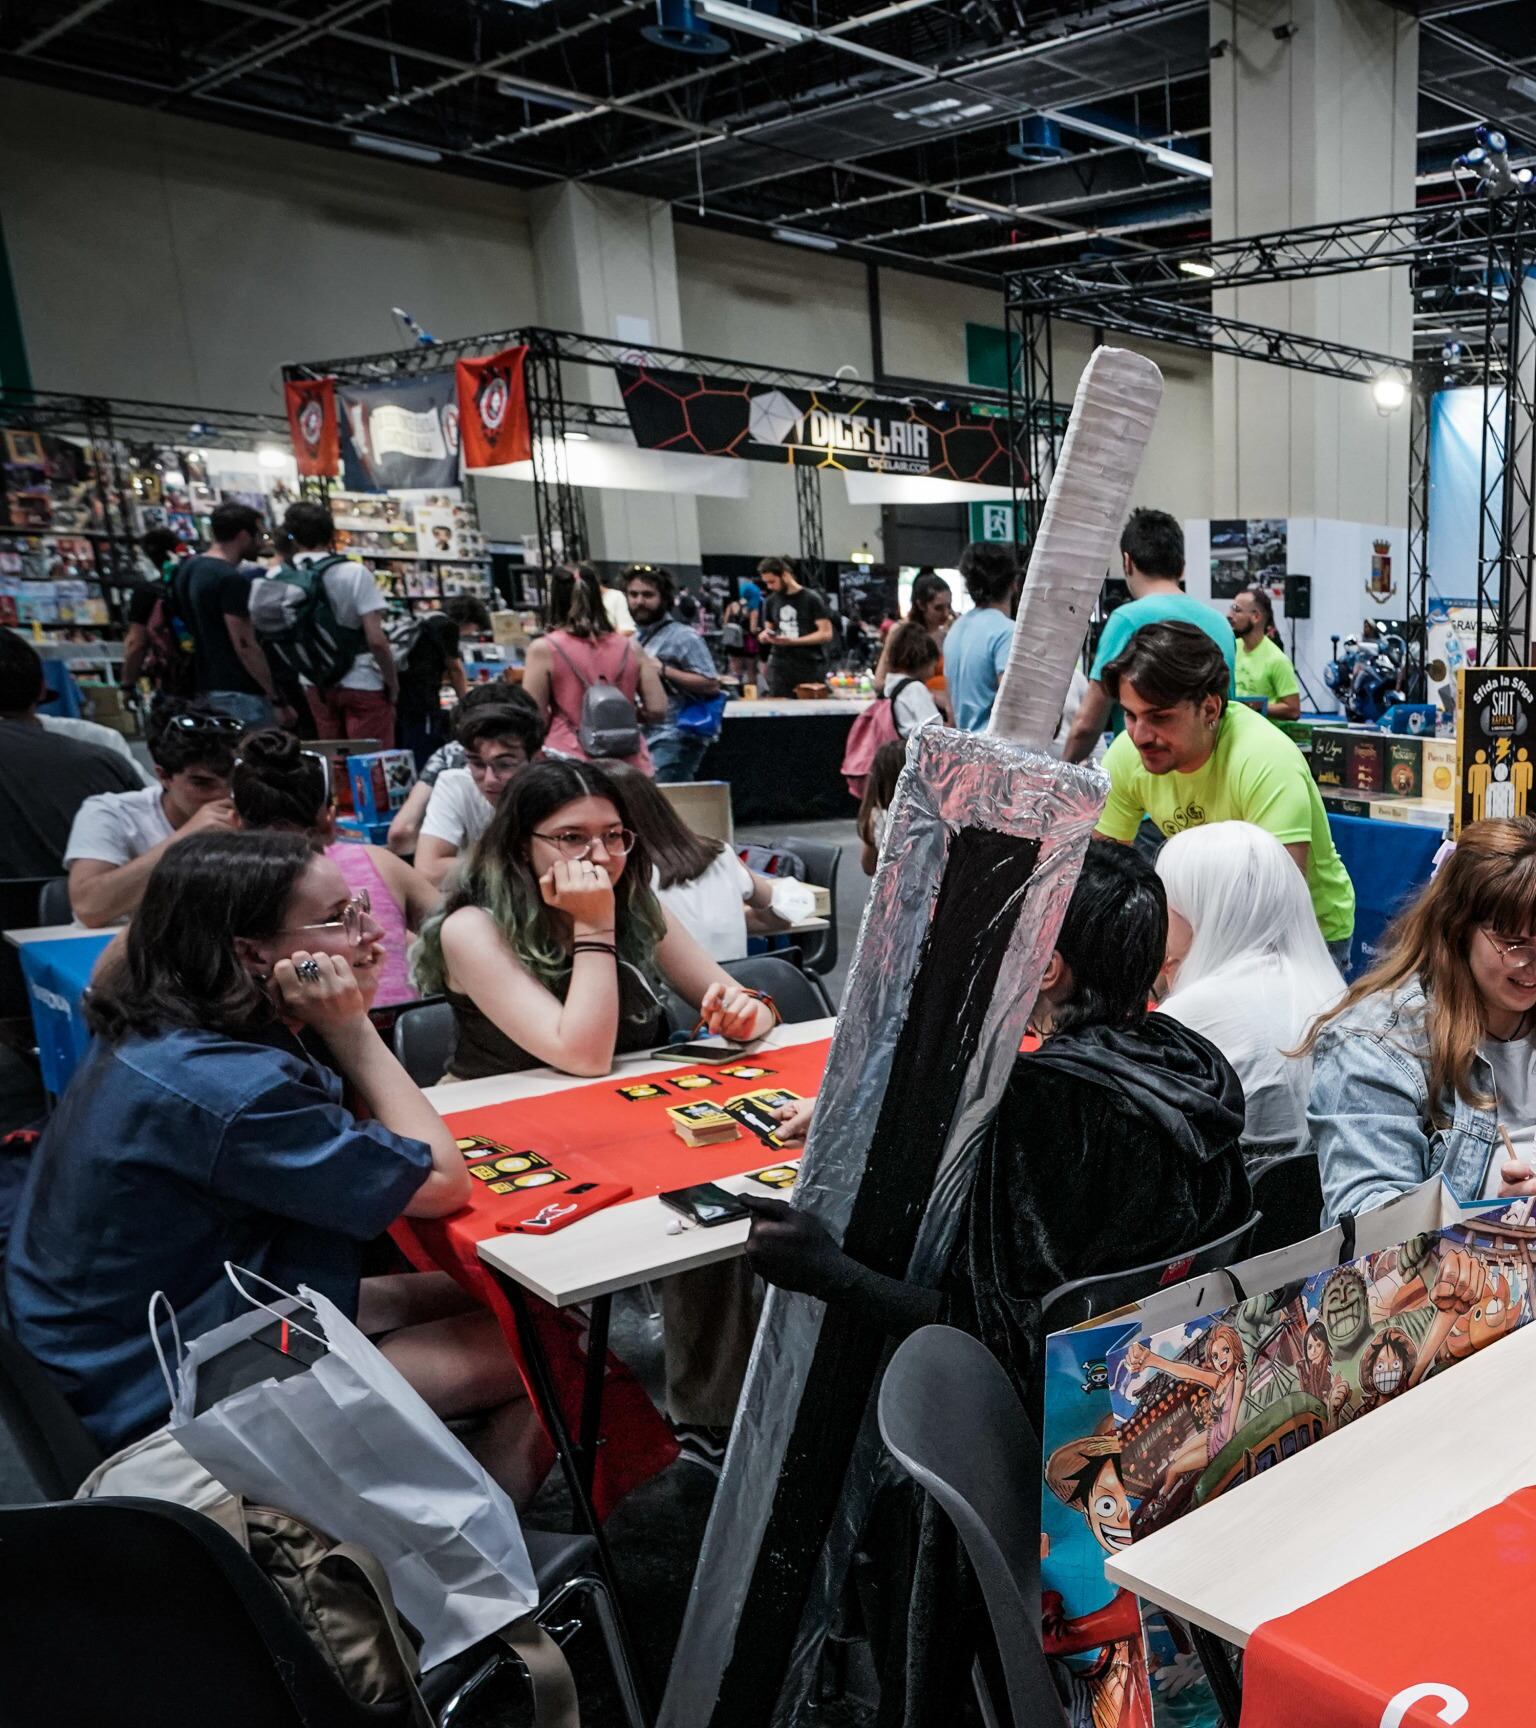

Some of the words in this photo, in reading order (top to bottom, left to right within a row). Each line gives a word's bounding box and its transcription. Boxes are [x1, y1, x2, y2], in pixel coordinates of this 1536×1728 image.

[811, 409, 870, 451] DICE
[874, 418, 929, 458] LAIR
[1473, 679, 1498, 704] Sfida
[1500, 675, 1509, 686] la
[1511, 677, 1534, 703] Sfiga
[1492, 691, 1515, 716] SHIT
